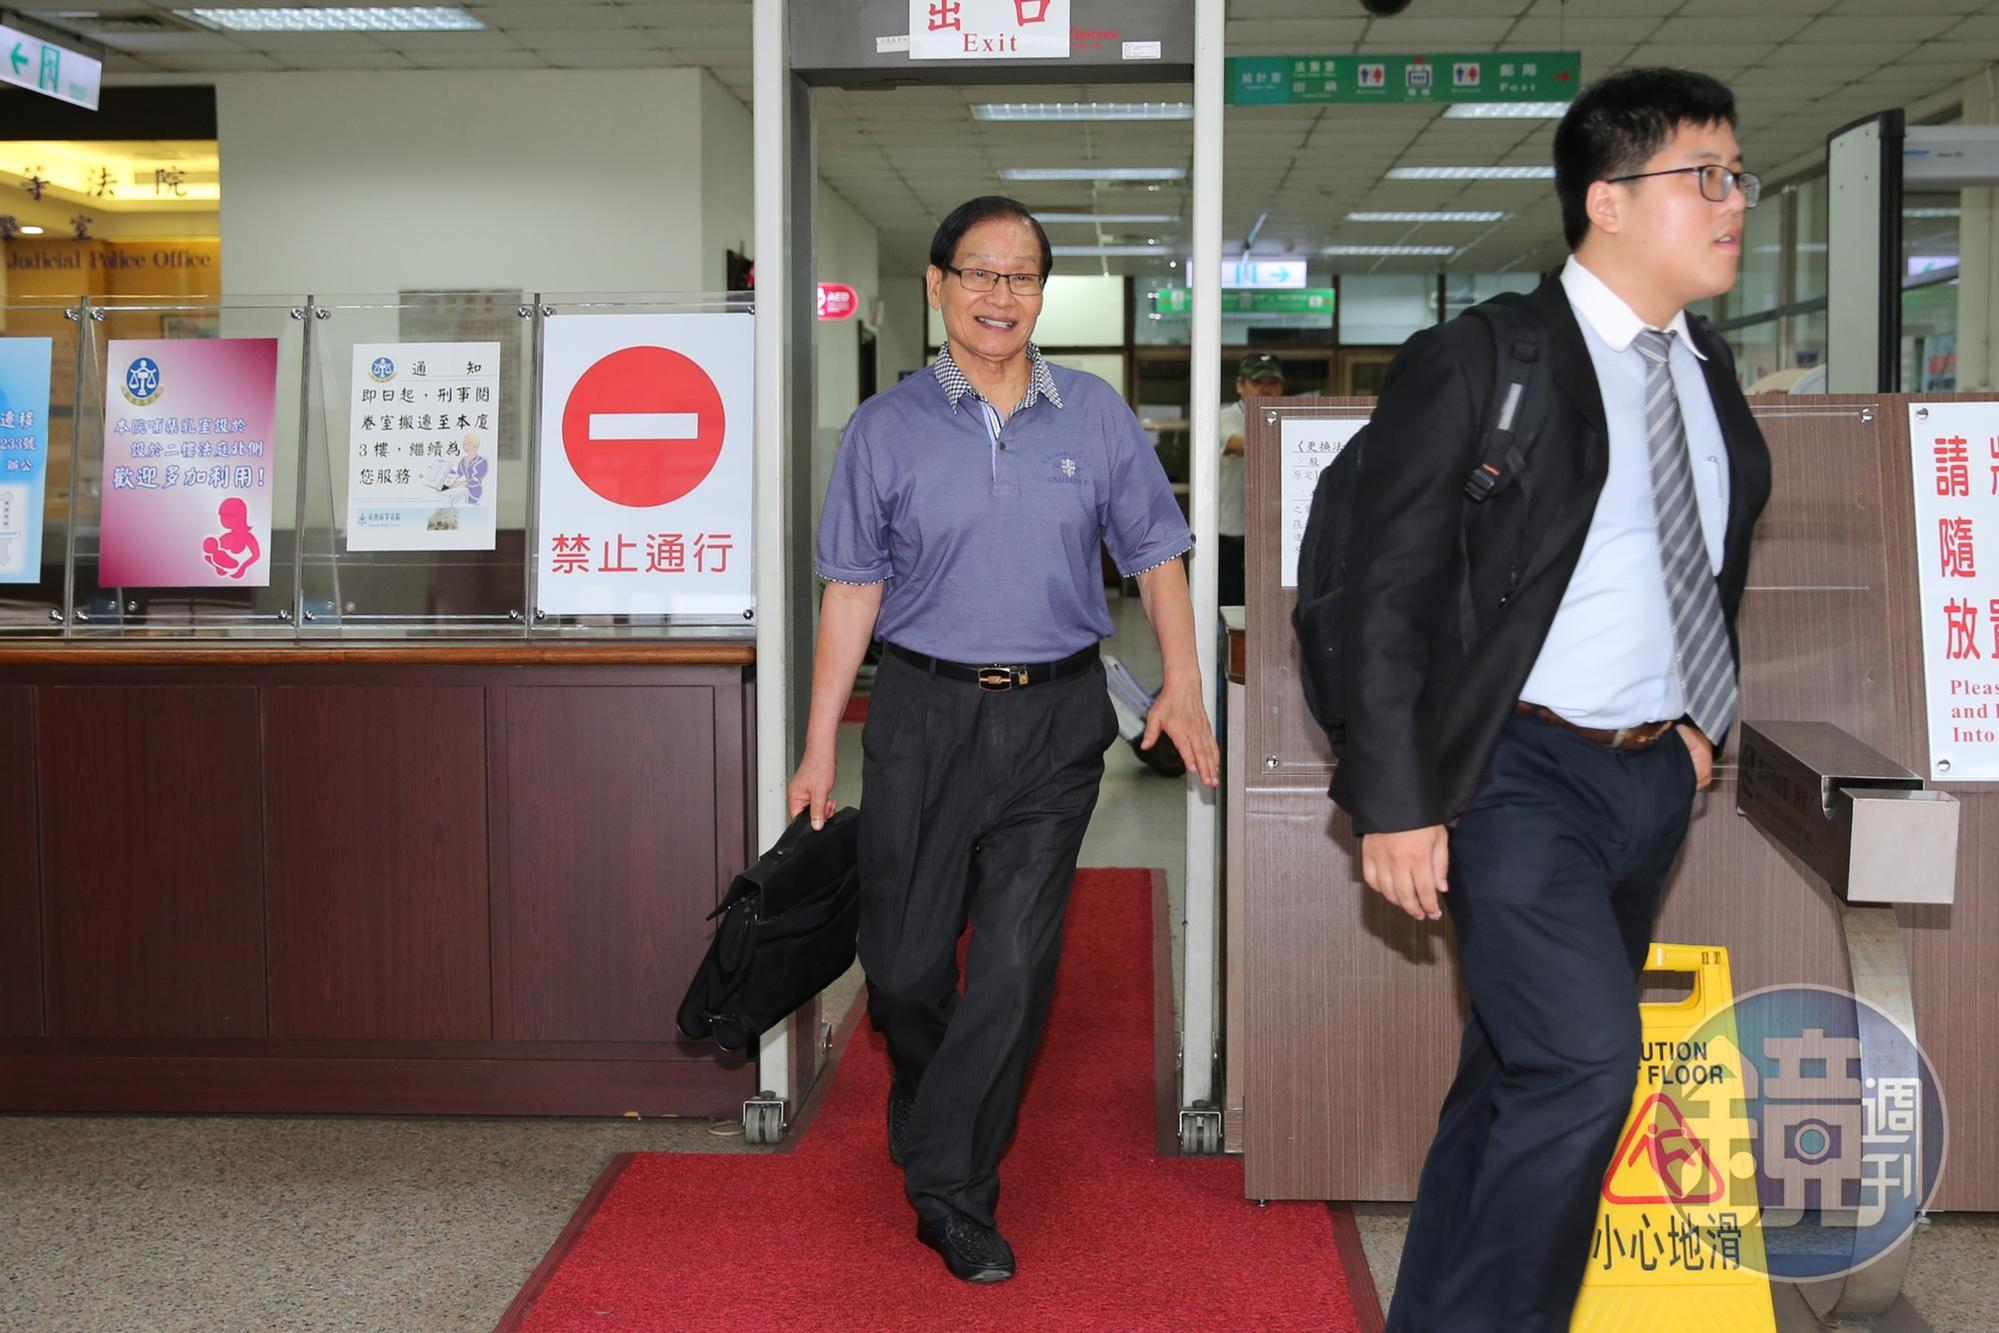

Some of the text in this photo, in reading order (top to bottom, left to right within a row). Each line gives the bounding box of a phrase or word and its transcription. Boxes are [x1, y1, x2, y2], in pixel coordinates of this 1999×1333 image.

[963, 33, 1018, 52] Exit
[1500, 83, 1536, 92] Post
[7, 250, 210, 270] Judicial Police Office
[412, 361, 482, 377] 通知
[0, 411, 34, 428] 遷移
[551, 532, 734, 575] 禁止通行
[1938, 516, 1976, 578] 隨
[1951, 703, 1988, 719] and
[1953, 727, 1994, 742] Into
[1641, 1042, 1708, 1062] UTION
[1648, 1065, 1723, 1085] FLOOR
[1593, 1212, 1742, 1272] 小心地滑
